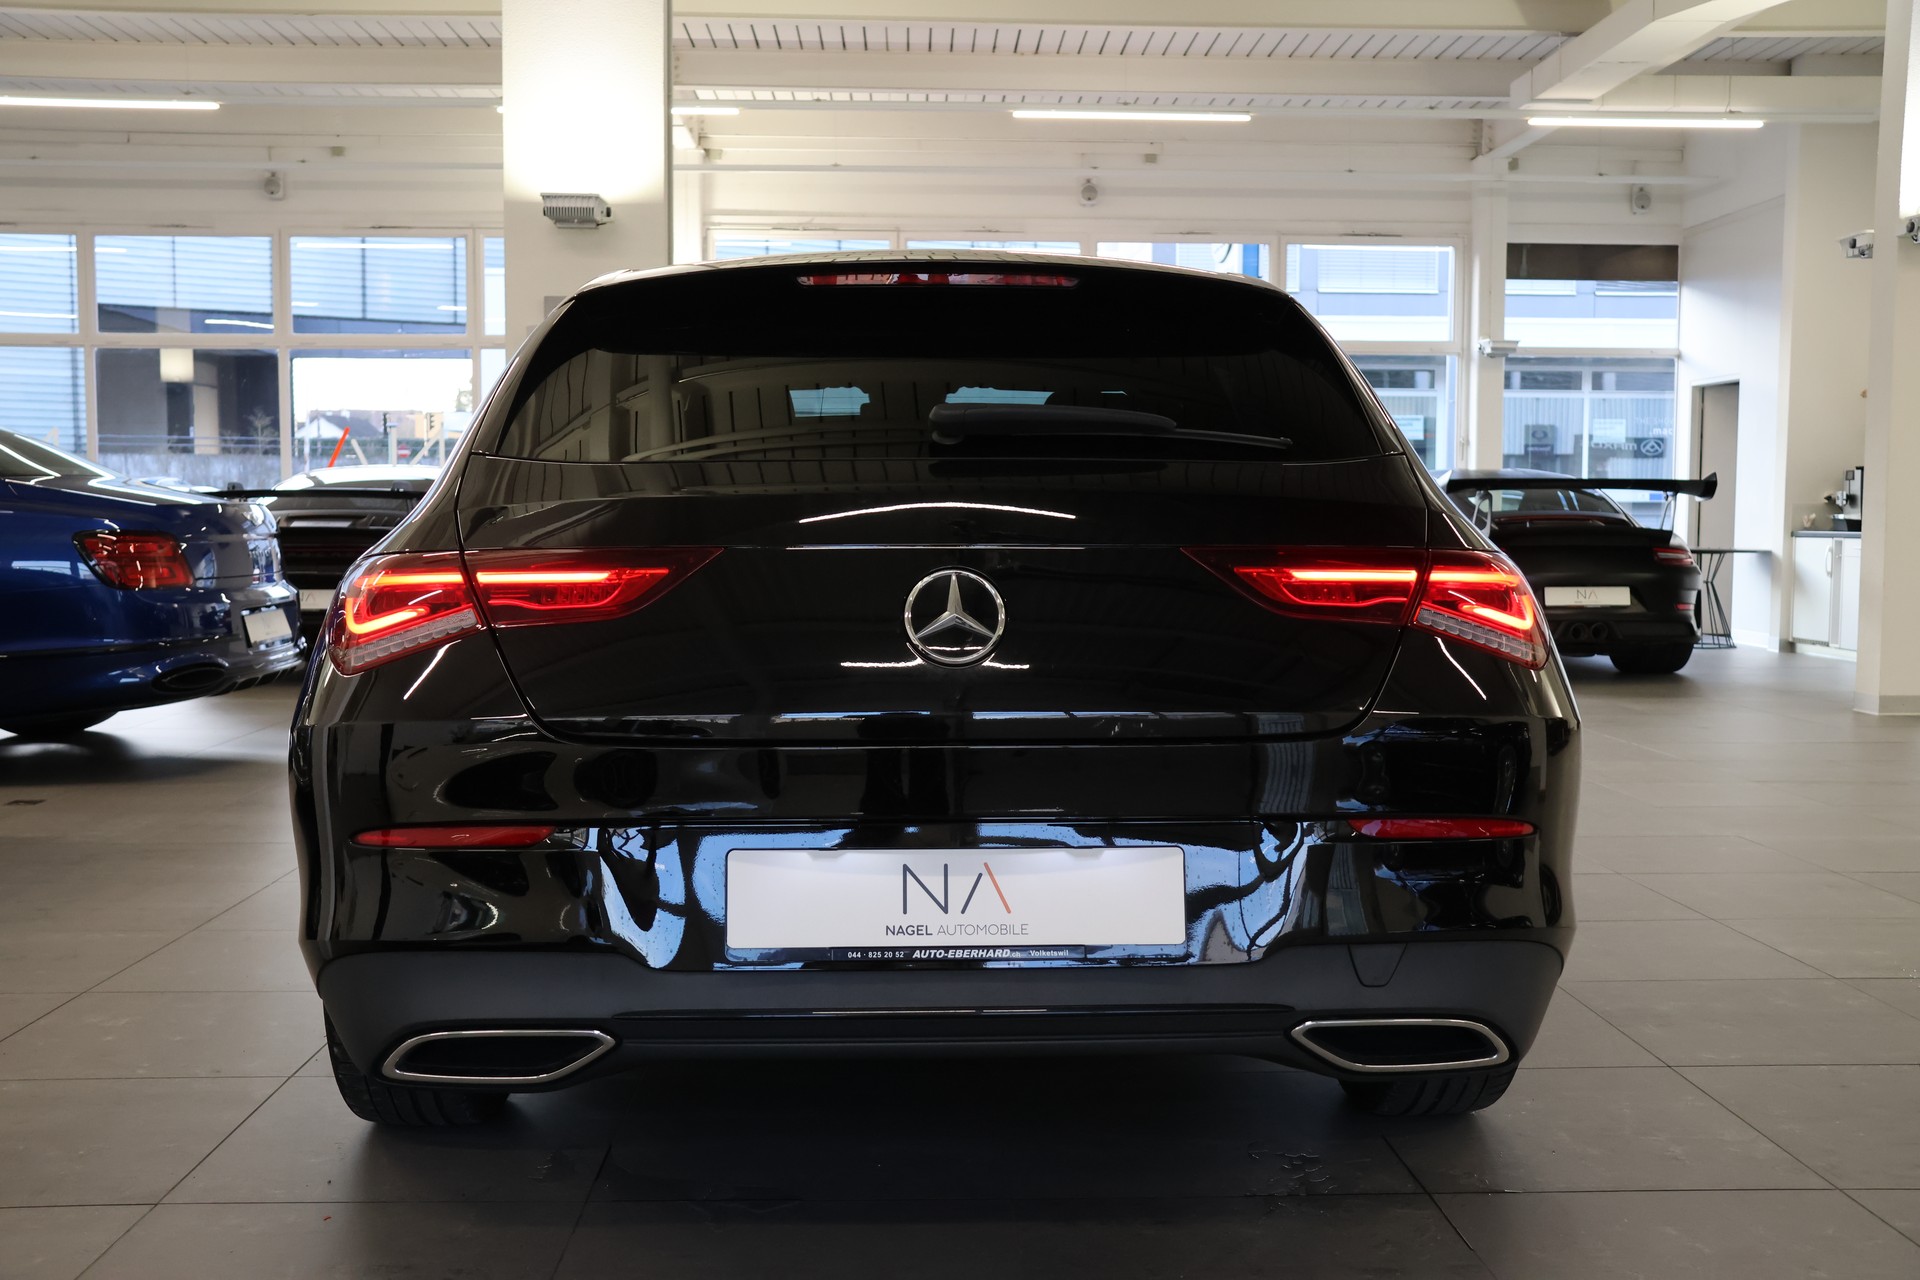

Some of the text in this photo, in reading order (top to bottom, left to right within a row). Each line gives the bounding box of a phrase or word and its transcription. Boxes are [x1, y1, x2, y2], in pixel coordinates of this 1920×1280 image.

[902, 862, 1012, 915] NA
[885, 923, 1029, 936] NAGEL AUTOMOBILE
[847, 951, 861, 959] 044
[1029, 949, 1069, 957] Volketswil
